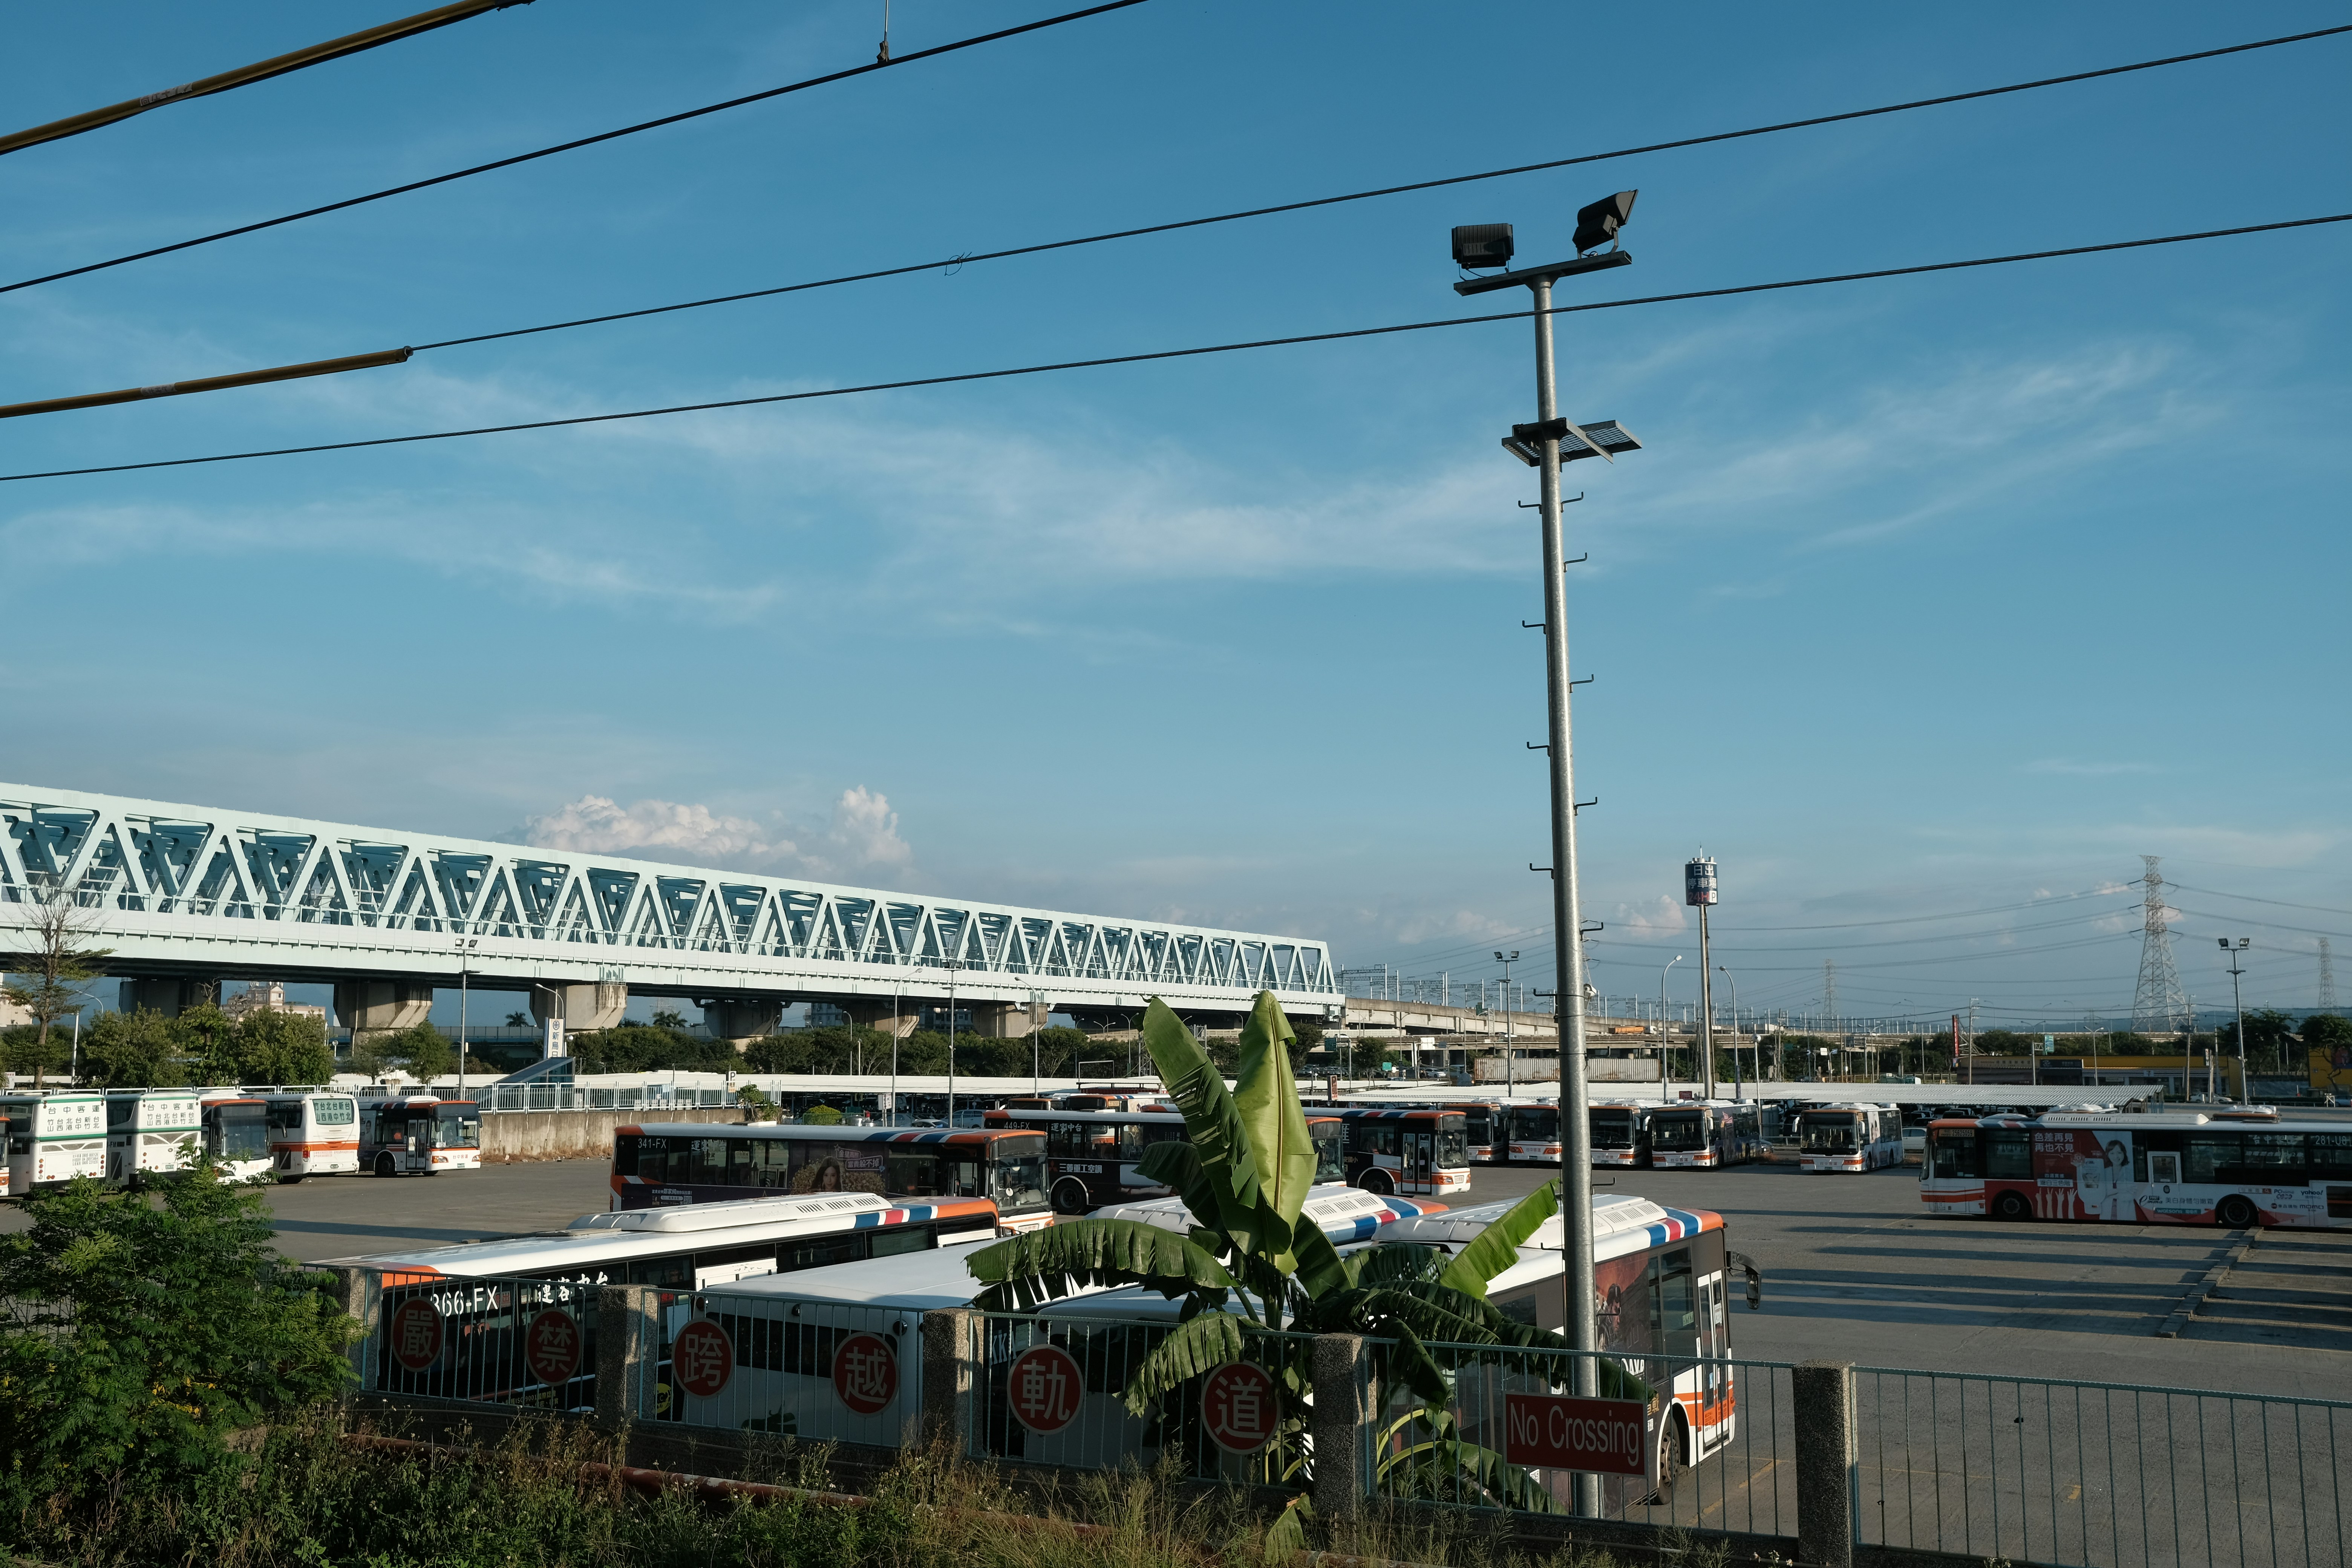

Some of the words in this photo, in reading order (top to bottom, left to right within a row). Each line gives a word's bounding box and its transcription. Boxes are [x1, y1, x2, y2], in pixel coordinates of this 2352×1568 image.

[1694, 865, 1714, 876] 日出
[1688, 877, 1717, 889] 停車場
[1688, 892, 1709, 902] 24H
[48, 1105, 100, 1115] 台中客運
[1004, 1121, 1030, 1130] 449-FX
[2035, 1132, 2074, 1142] 色差再見
[638, 1138, 666, 1149] 341-FX
[2035, 1143, 2074, 1153] 再也不見
[1059, 1163, 1102, 1173] 三菱重工空調
[1510, 1402, 1539, 1447] No
[1548, 1405, 1639, 1468] Crossing
